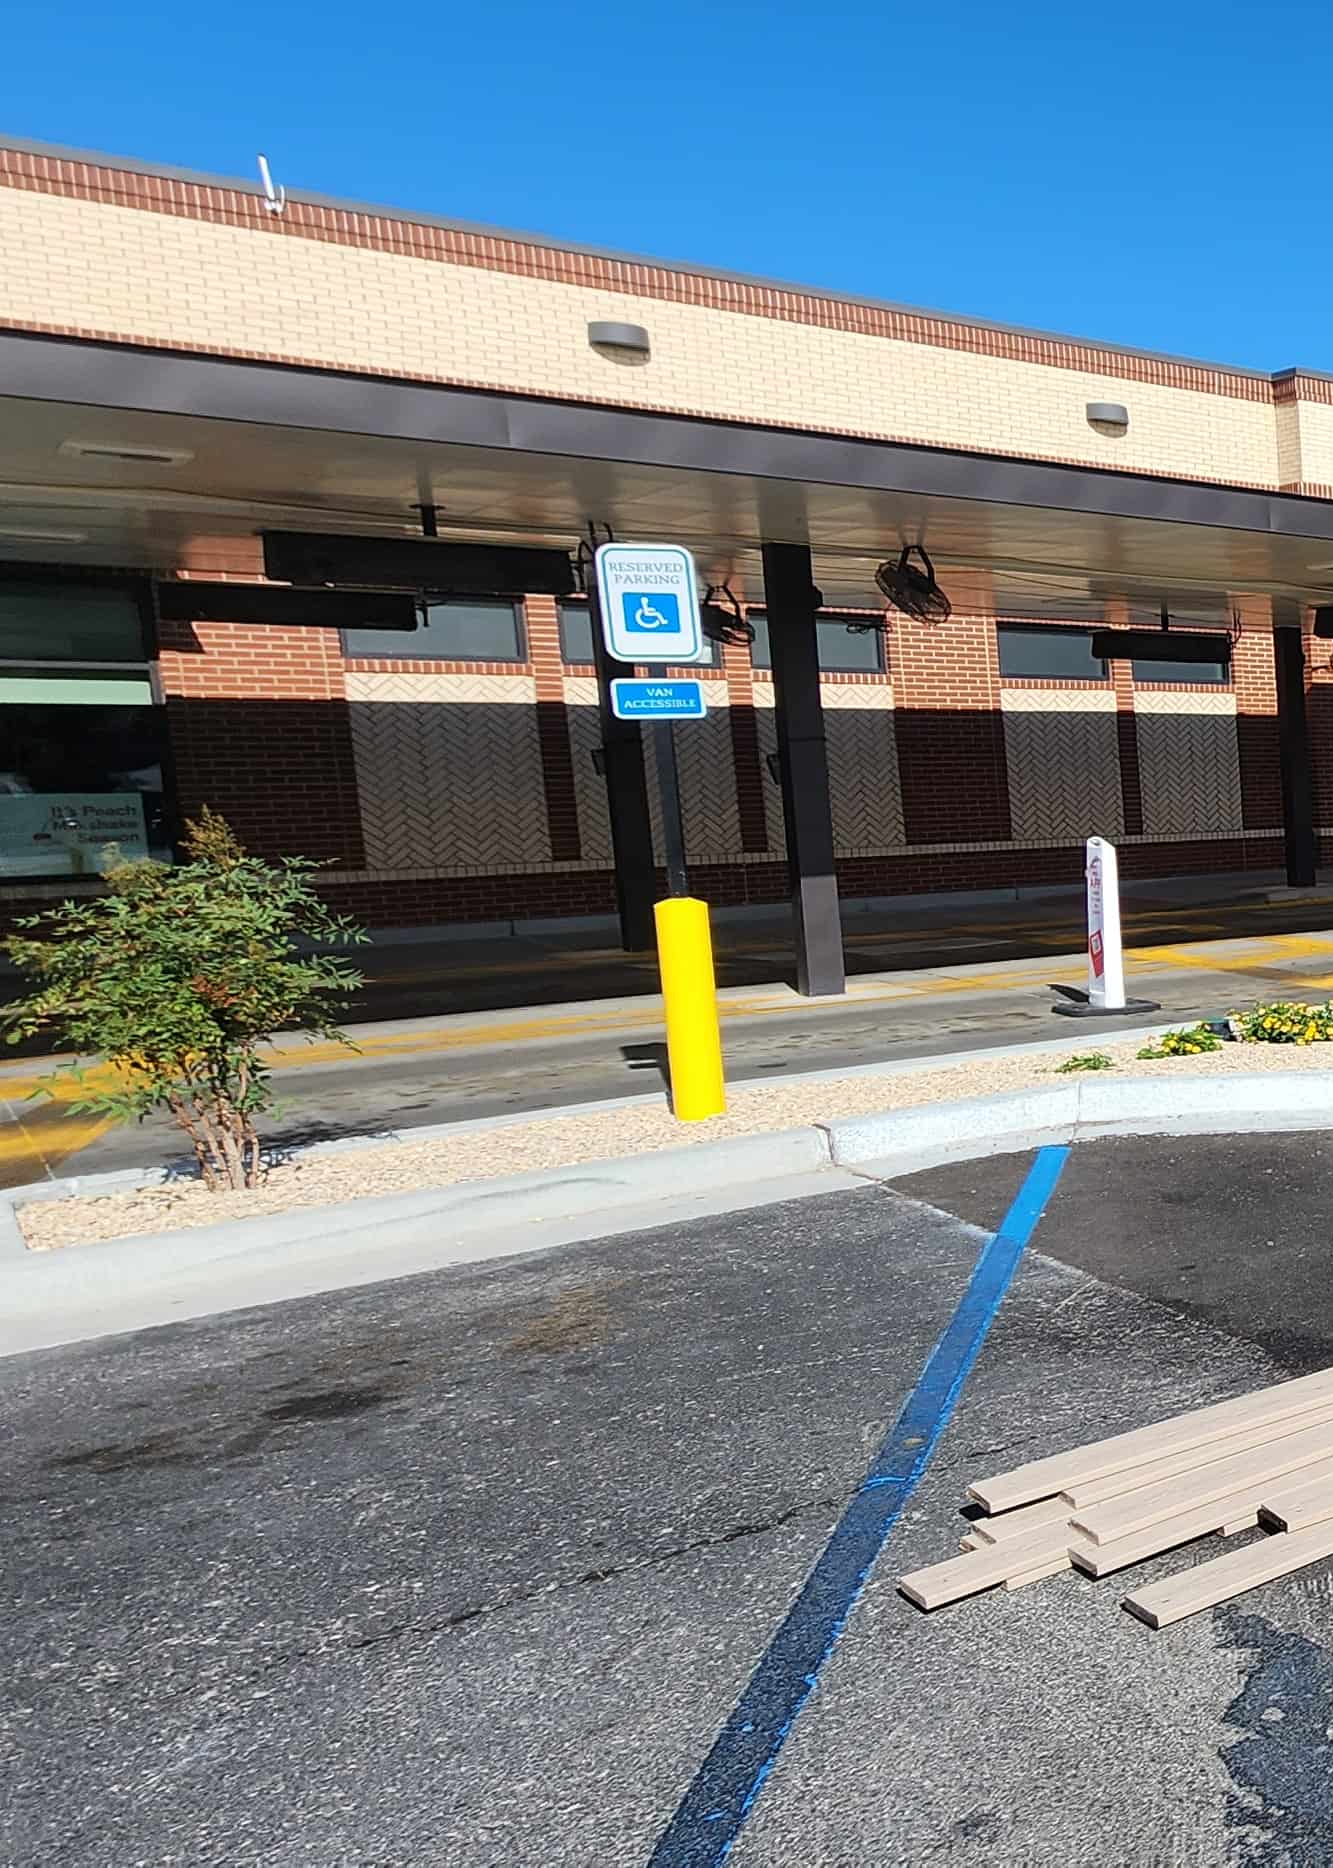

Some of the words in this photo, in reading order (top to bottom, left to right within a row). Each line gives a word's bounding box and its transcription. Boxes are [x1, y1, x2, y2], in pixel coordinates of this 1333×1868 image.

[608, 562, 683, 573] RESERVED
[614, 574, 681, 585] PARKING
[646, 687, 673, 697] VAN
[624, 699, 697, 709] ACCESSIBLE
[81, 805, 137, 817] Peach
[52, 818, 138, 831] Mshake
